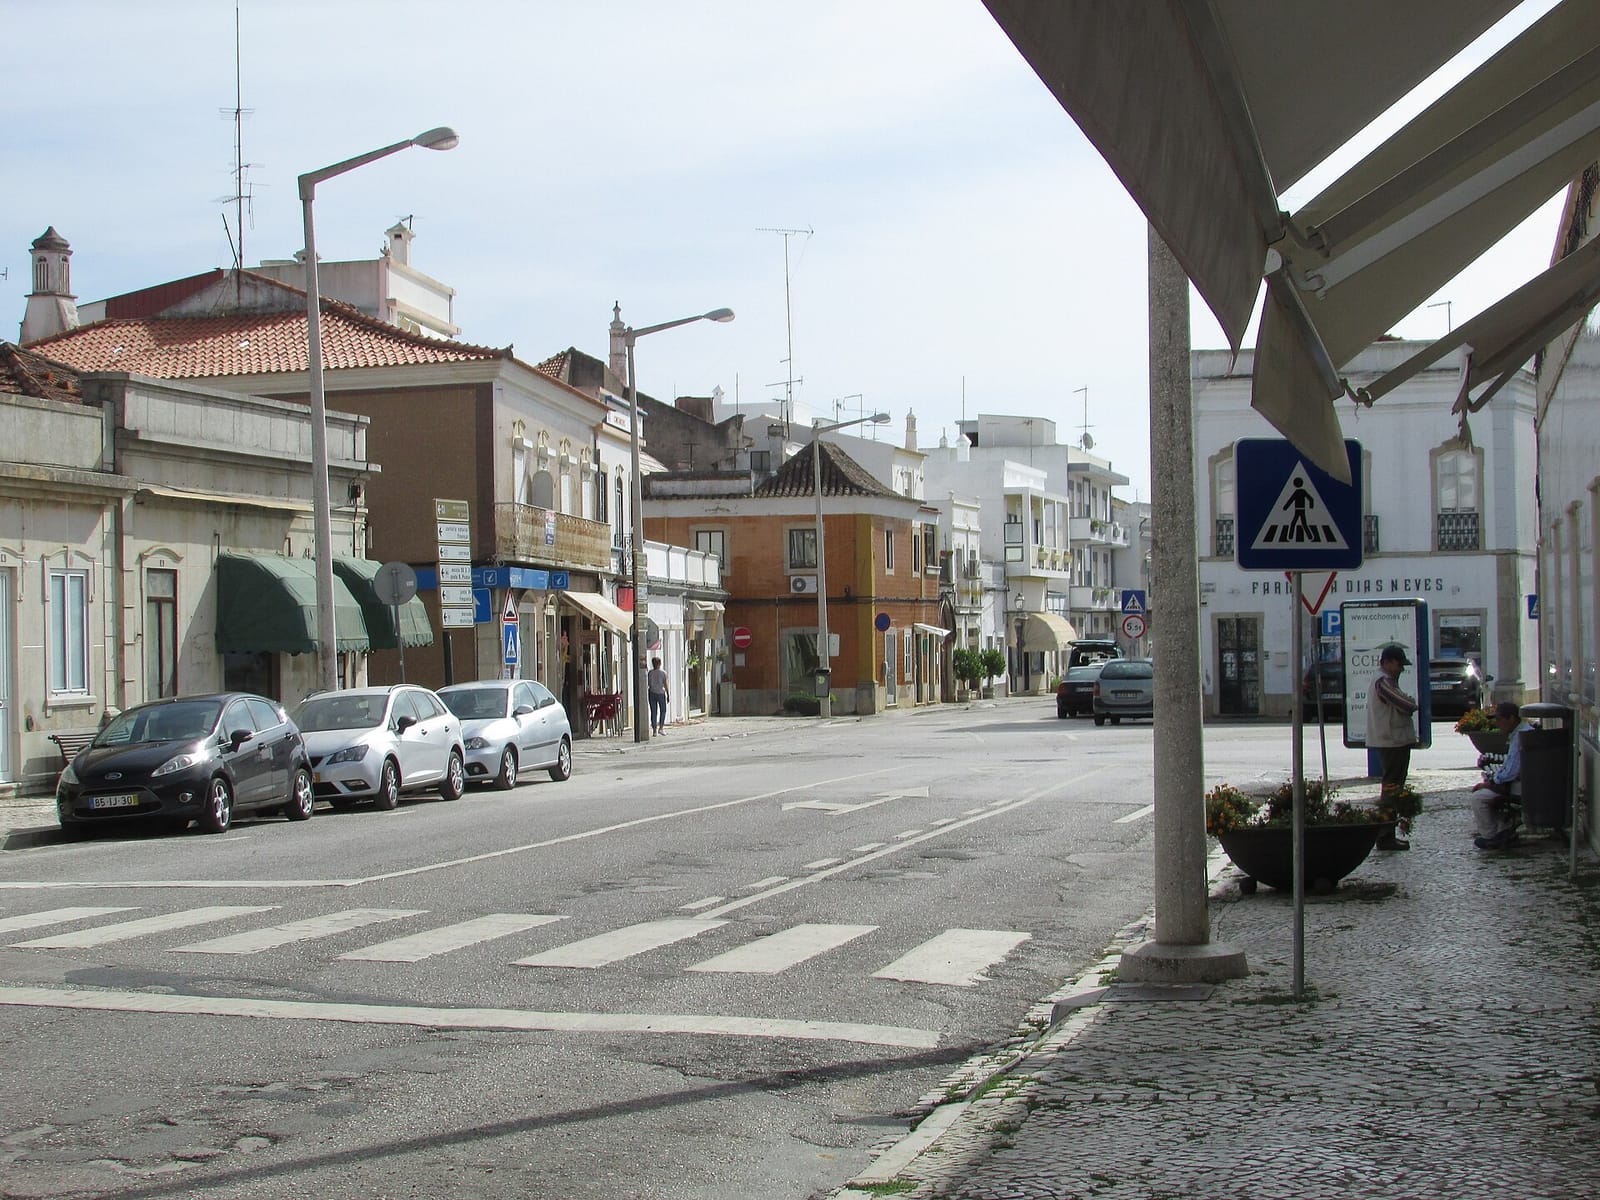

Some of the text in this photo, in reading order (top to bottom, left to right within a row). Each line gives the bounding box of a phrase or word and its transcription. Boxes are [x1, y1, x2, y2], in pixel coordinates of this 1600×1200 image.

[1346, 580, 1383, 594] DIAS
[1391, 578, 1443, 592] NEVES
[1327, 612, 1340, 633] P
